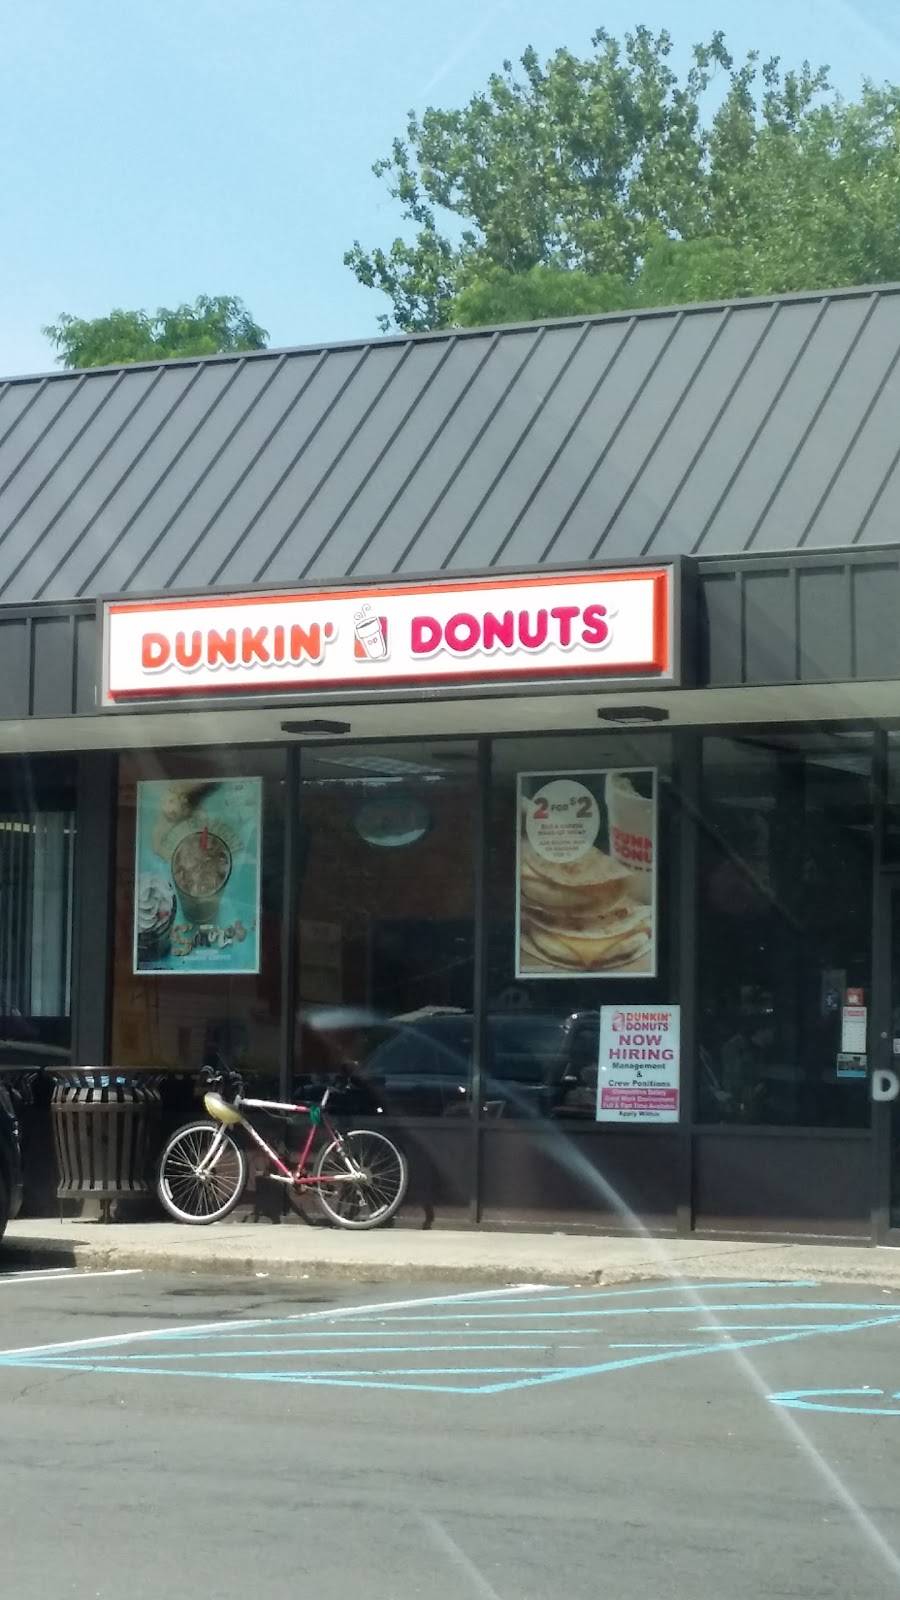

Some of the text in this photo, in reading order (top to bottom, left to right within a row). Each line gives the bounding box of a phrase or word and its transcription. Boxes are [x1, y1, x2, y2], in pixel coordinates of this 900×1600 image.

[141, 604, 609, 668] DUNKIN' DONUTS
[533, 797, 549, 819] 2
[551, 803, 569, 812] FOR
[626, 1012, 672, 1022] DUNKIN'
[626, 1022, 669, 1032] DONUTS
[619, 1034, 662, 1046] NOW
[608, 1048, 674, 1060] HIRING
[612, 1062, 666, 1071] Management
[608, 1079, 671, 1087] Crew Positions
